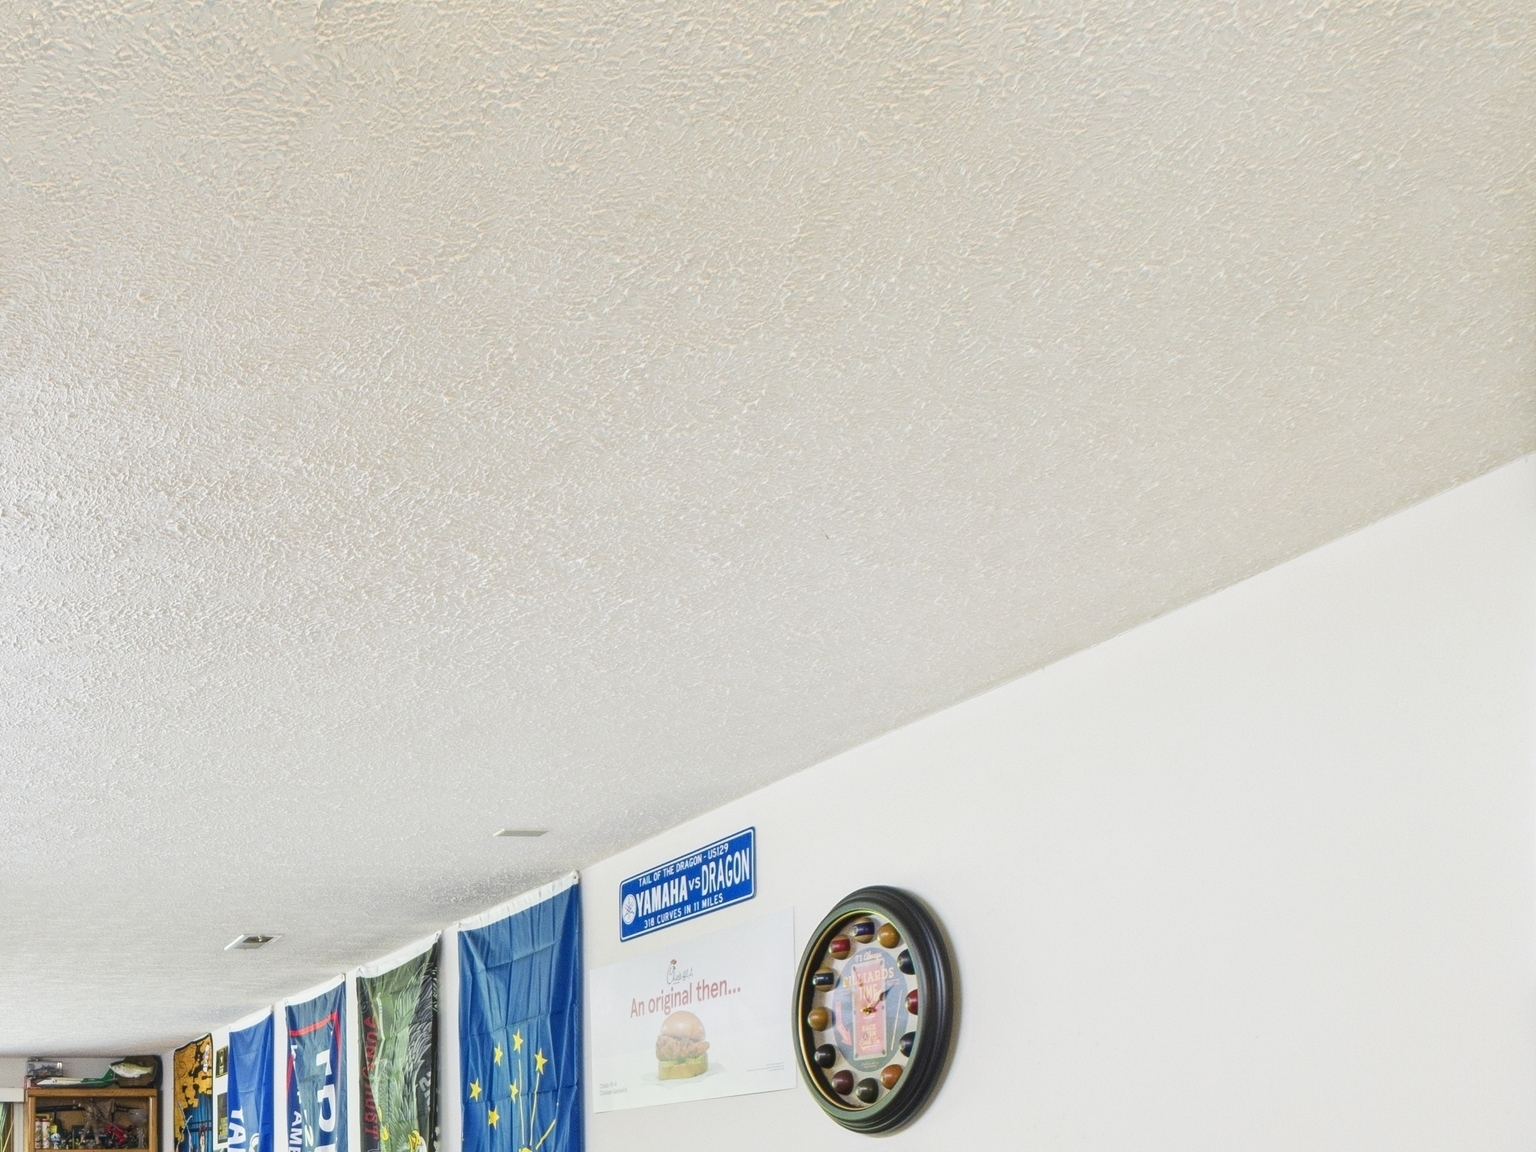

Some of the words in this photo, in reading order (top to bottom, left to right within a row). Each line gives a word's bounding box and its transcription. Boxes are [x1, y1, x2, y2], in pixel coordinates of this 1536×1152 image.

[636, 875, 688, 918] YAMAHA
[702, 848, 750, 897] DRAGON
[638, 876, 652, 887] TAIL
[653, 871, 662, 881] OF
[663, 867, 674, 878] THE
[676, 854, 702, 873] DRAGON
[708, 843, 729, 860] US129
[644, 919, 655, 929] 318
[657, 908, 682, 925] CURVES
[684, 904, 691, 916] IN
[694, 900, 700, 912] 11
[702, 893, 724, 909] MILES
[630, 998, 645, 1018] An
[648, 982, 692, 1016] original
[696, 979, 741, 1002] then...
